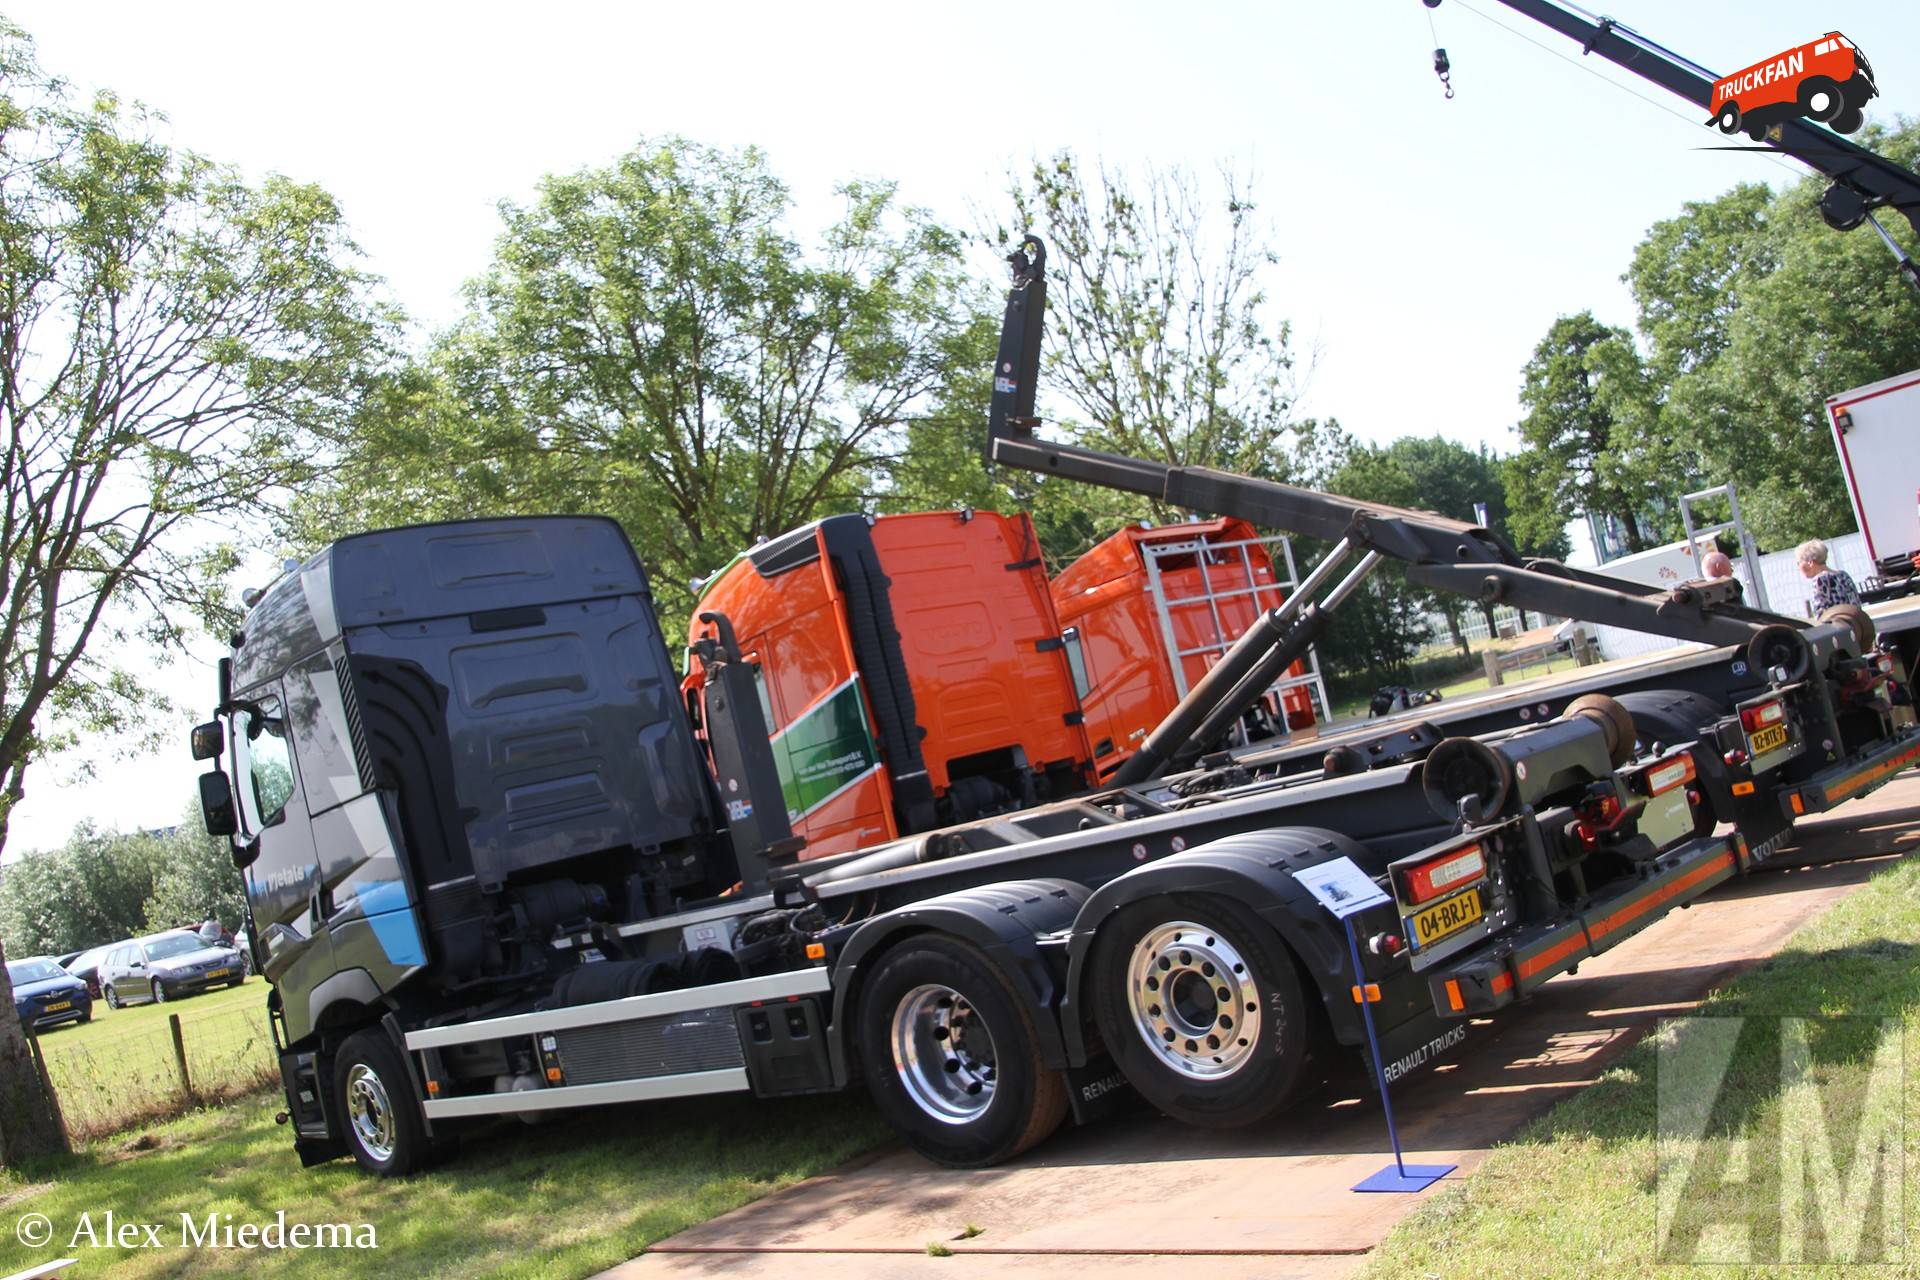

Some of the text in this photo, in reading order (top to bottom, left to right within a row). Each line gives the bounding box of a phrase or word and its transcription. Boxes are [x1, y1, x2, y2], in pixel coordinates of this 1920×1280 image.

[1421, 895, 1475, 938] 04-BRJ-1
[1383, 1024, 1466, 1084] RENAULT TRUCKS
